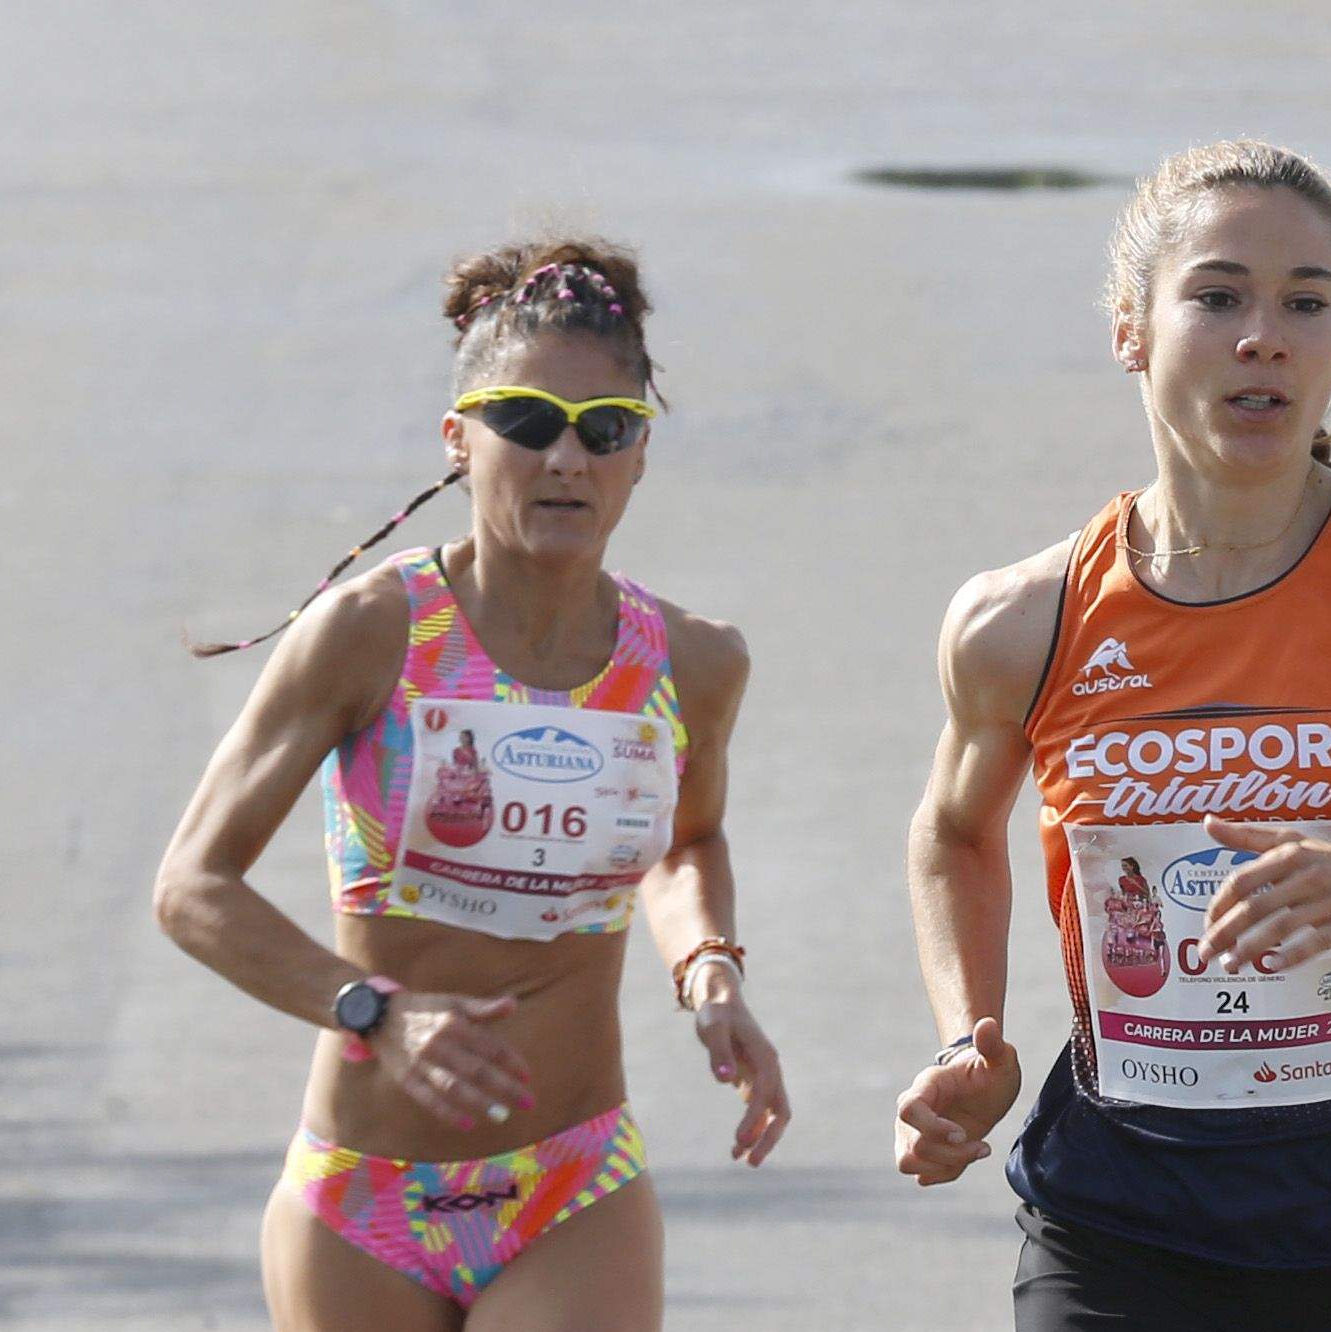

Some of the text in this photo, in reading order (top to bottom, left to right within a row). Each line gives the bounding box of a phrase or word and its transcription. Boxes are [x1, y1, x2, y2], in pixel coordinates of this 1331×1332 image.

[1072, 674, 1153, 696] austral
[502, 744, 595, 770] ASTURIANA
[612, 746, 656, 761] SUMA
[501, 801, 588, 838] 016
[531, 848, 546, 867] 3
[505, 875, 526, 889] DE
[529, 878, 550, 890] LA
[419, 883, 497, 915] OYSHO
[1216, 990, 1250, 1015] 24
[1124, 1022, 1195, 1042] CARRERA
[1199, 1029, 1226, 1043] DE
[1229, 1029, 1253, 1043] LA
[1257, 1023, 1320, 1042] MUJER
[1121, 1058, 1198, 1087] OYSHO
